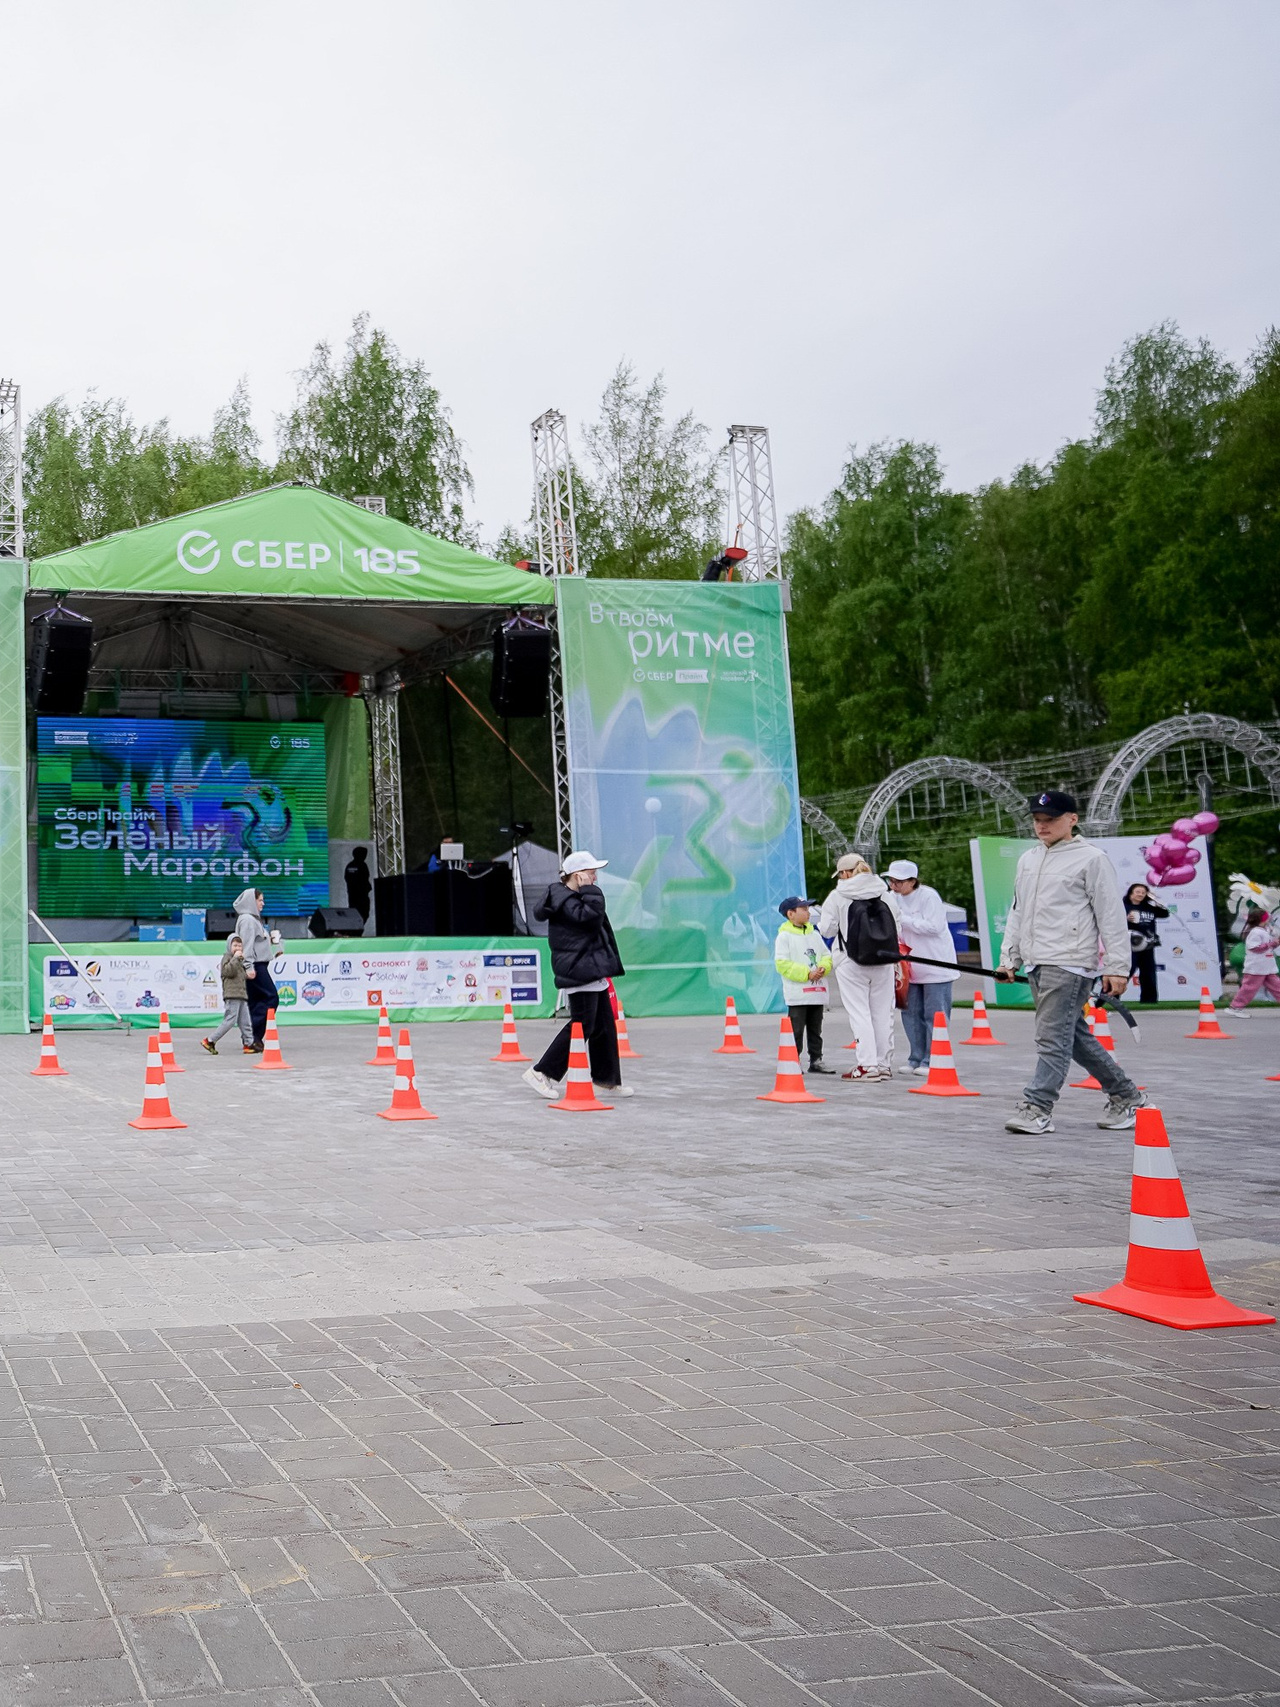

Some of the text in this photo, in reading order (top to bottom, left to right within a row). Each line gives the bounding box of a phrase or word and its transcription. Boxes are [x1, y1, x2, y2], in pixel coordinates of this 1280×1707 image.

[231, 540, 421, 575] СБЕР 185
[589, 603, 675, 628] В твоём
[628, 631, 755, 665] ритме
[647, 671, 673, 681] СБЕР
[54, 807, 156, 823] СберПрайм
[54, 823, 222, 850] Зелёный
[123, 850, 305, 884] Марафон
[156, 928, 166, 939] 2
[296, 961, 330, 975] Utair
